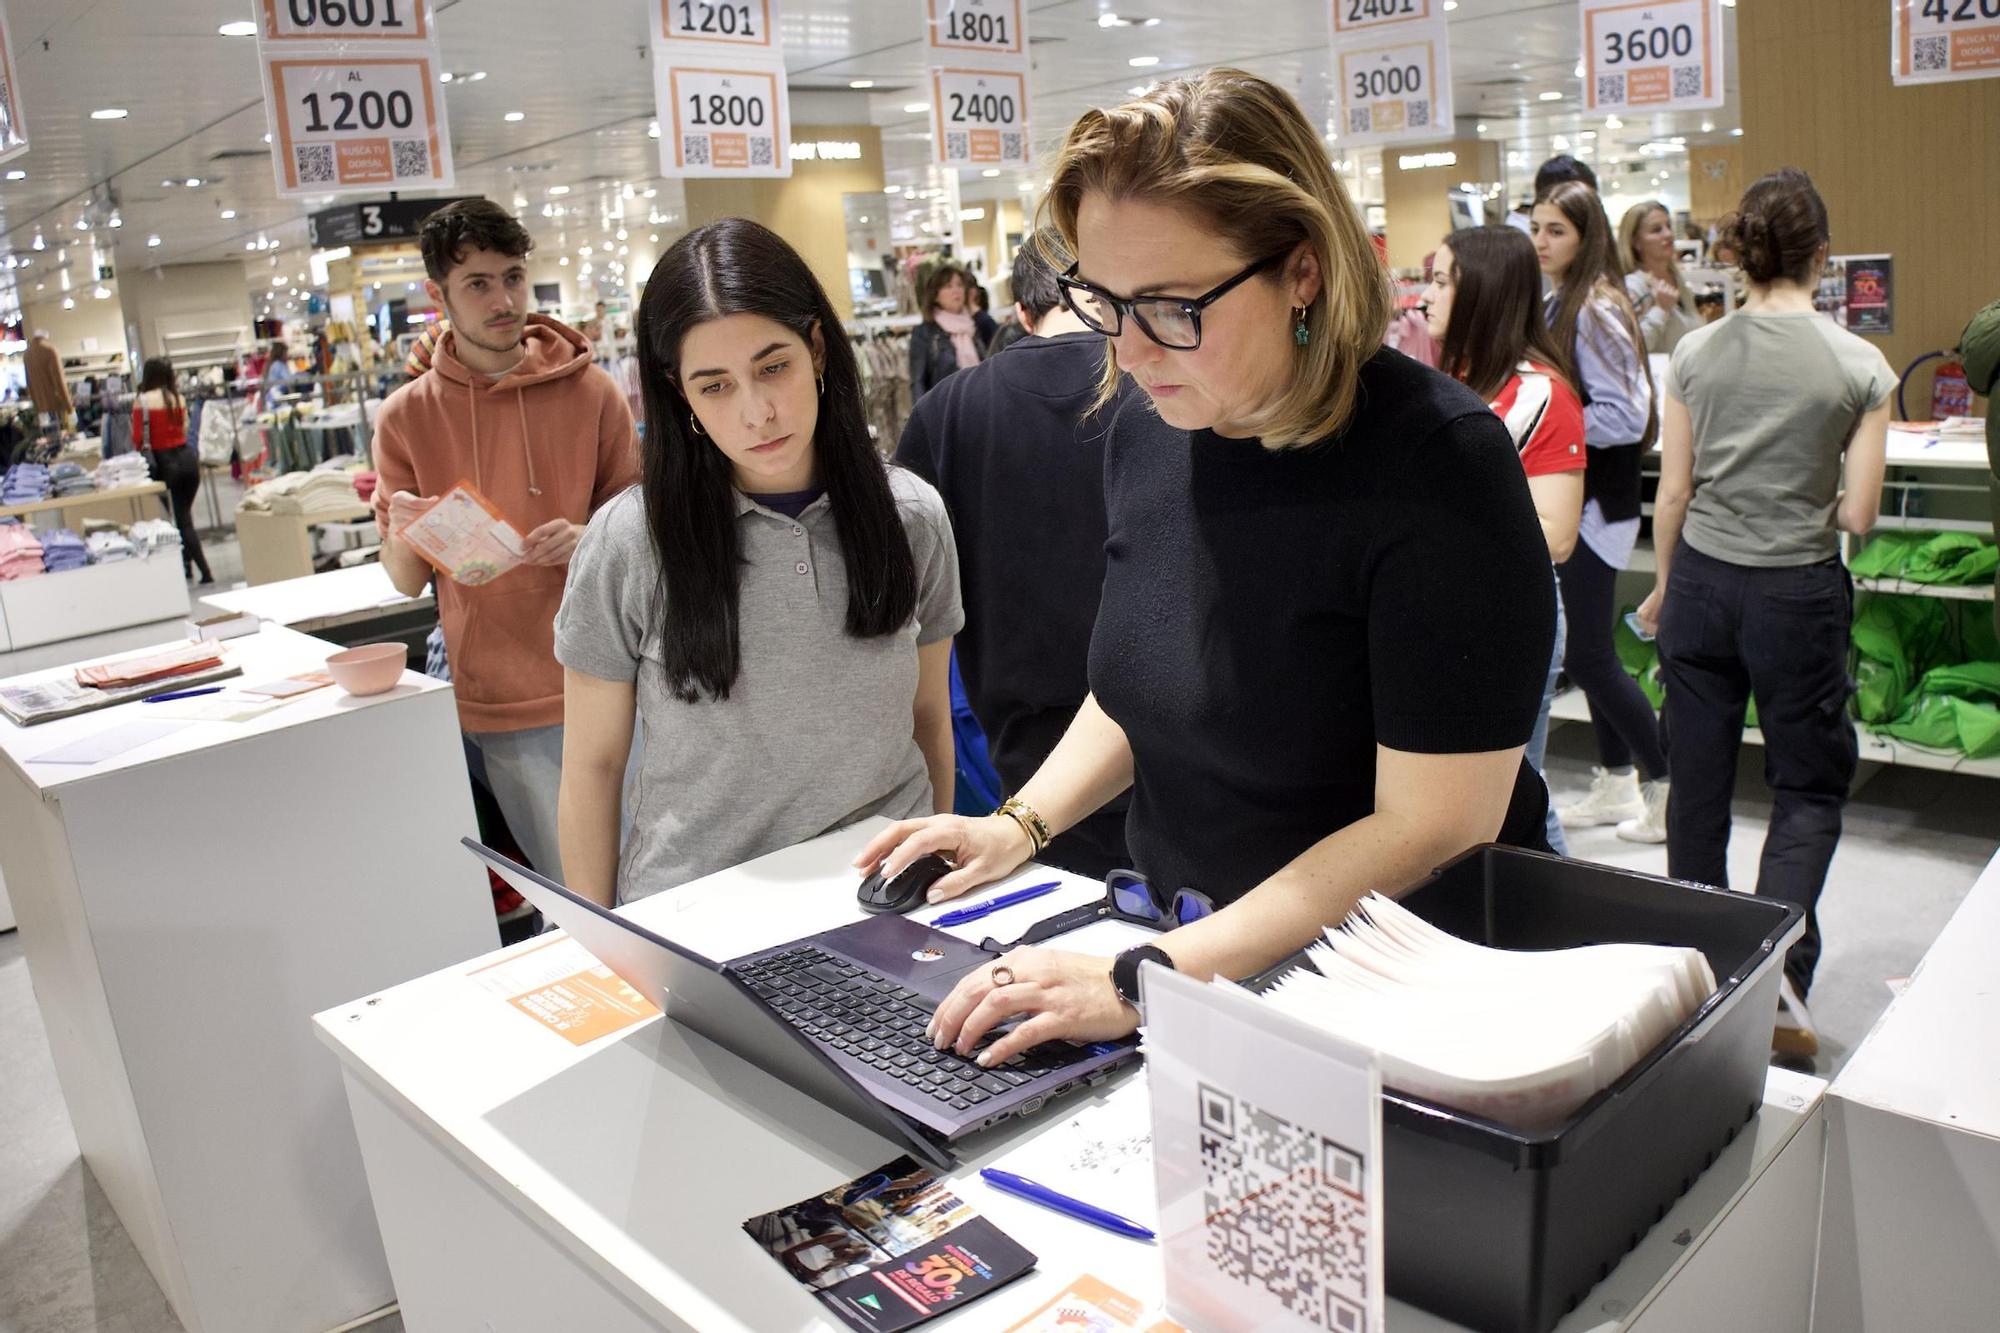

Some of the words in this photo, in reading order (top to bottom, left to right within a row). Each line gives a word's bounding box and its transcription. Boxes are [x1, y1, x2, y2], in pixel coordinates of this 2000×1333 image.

[289, 0, 403, 28] 0601
[679, 1, 755, 36] 1201
[946, 11, 1009, 44] 1801
[1604, 24, 1692, 64] 3600
[348, 71, 363, 82] AL
[720, 79, 732, 88] AL
[1354, 65, 1421, 98] 3000
[302, 90, 413, 132] 1200
[689, 93, 764, 127] 1800
[950, 93, 1014, 124] 2400
[362, 206, 383, 236] 3
[905, 1254, 964, 1300] 30%
